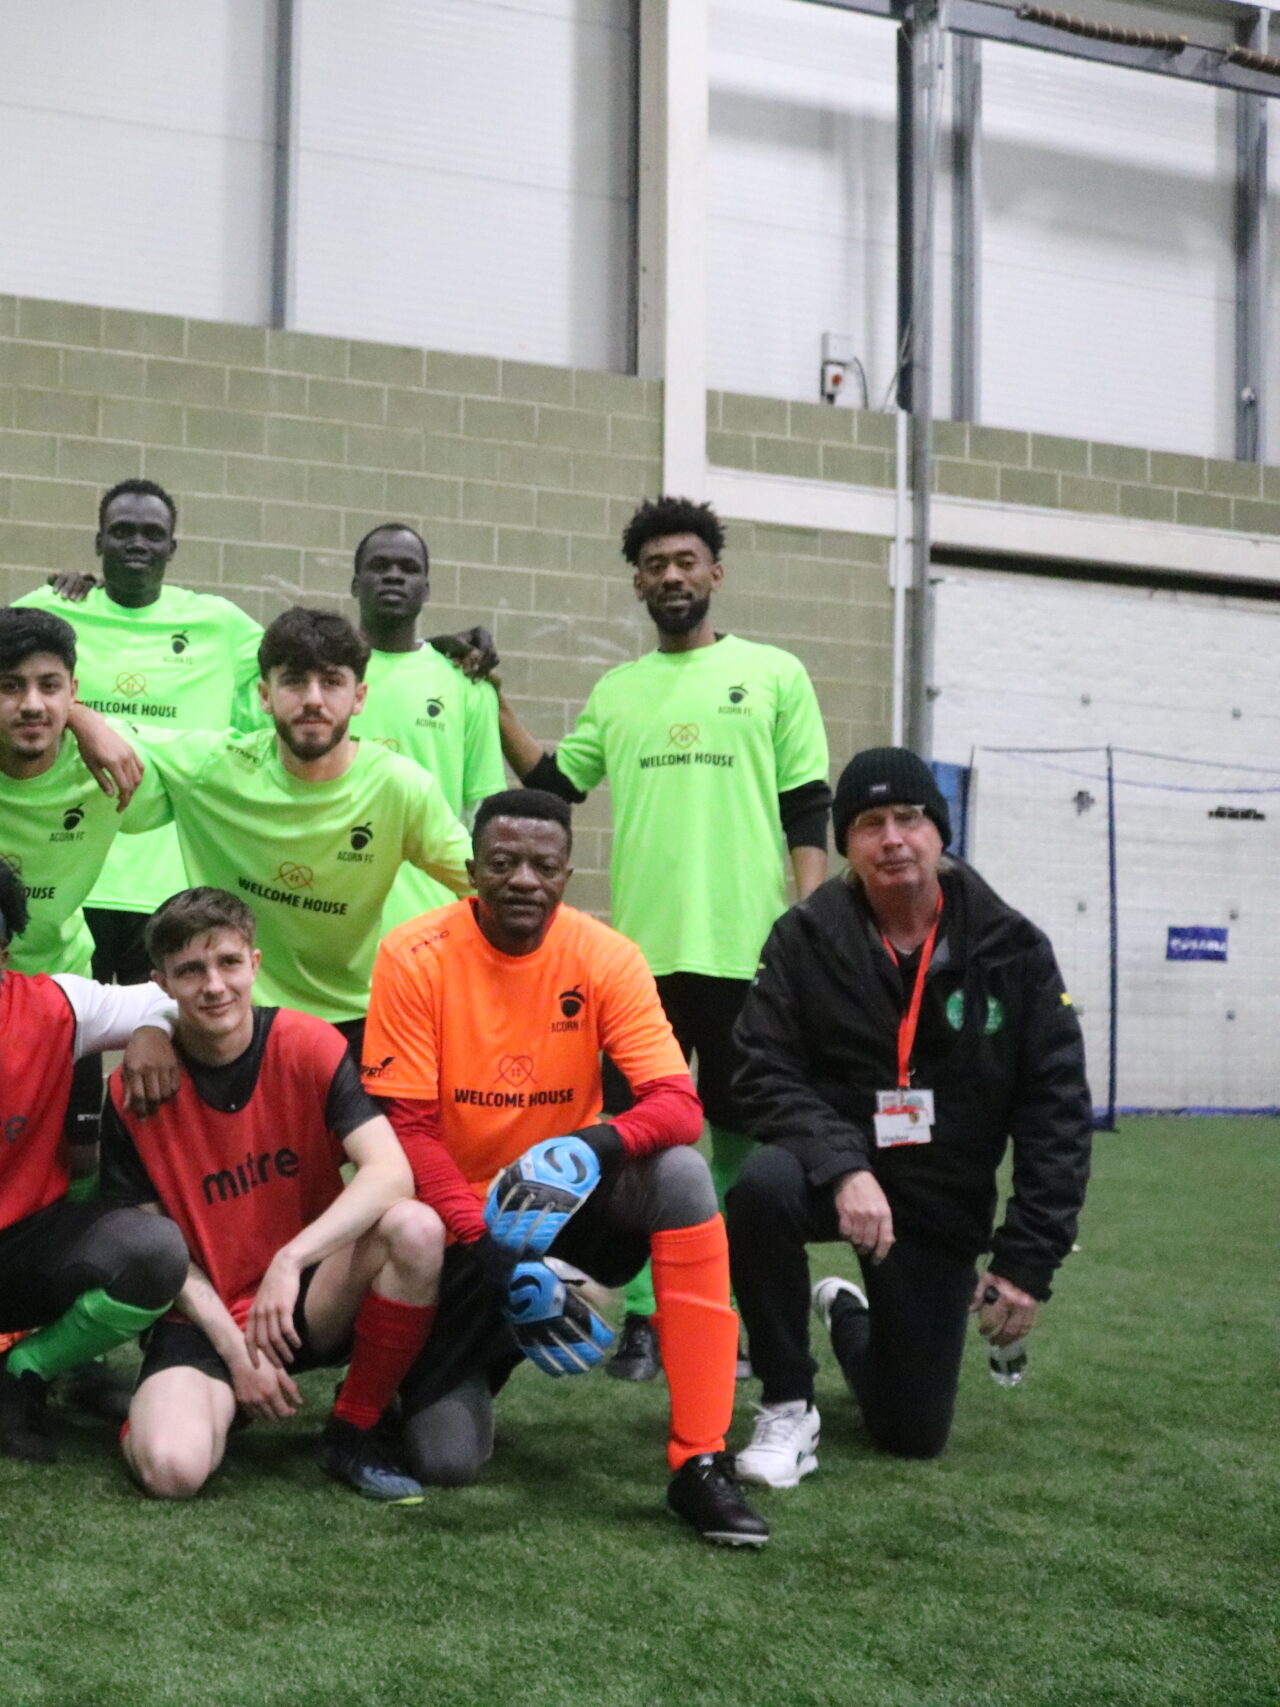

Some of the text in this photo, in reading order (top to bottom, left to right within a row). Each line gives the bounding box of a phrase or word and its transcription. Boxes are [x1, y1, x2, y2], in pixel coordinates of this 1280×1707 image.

[141, 704, 178, 718] HOUSE
[717, 706, 742, 714] ACORN
[640, 753, 734, 769] WELCOME HOUSE
[49, 831, 75, 842] ACORN
[337, 851, 375, 864] ACORN FC
[24, 886, 56, 900] OUSE
[238, 876, 349, 916] WELCOME HOUSE
[551, 1020, 579, 1033] ACORN
[454, 1088, 575, 1108] WELCOME HOUSE
[202, 1147, 300, 1206] mitre
